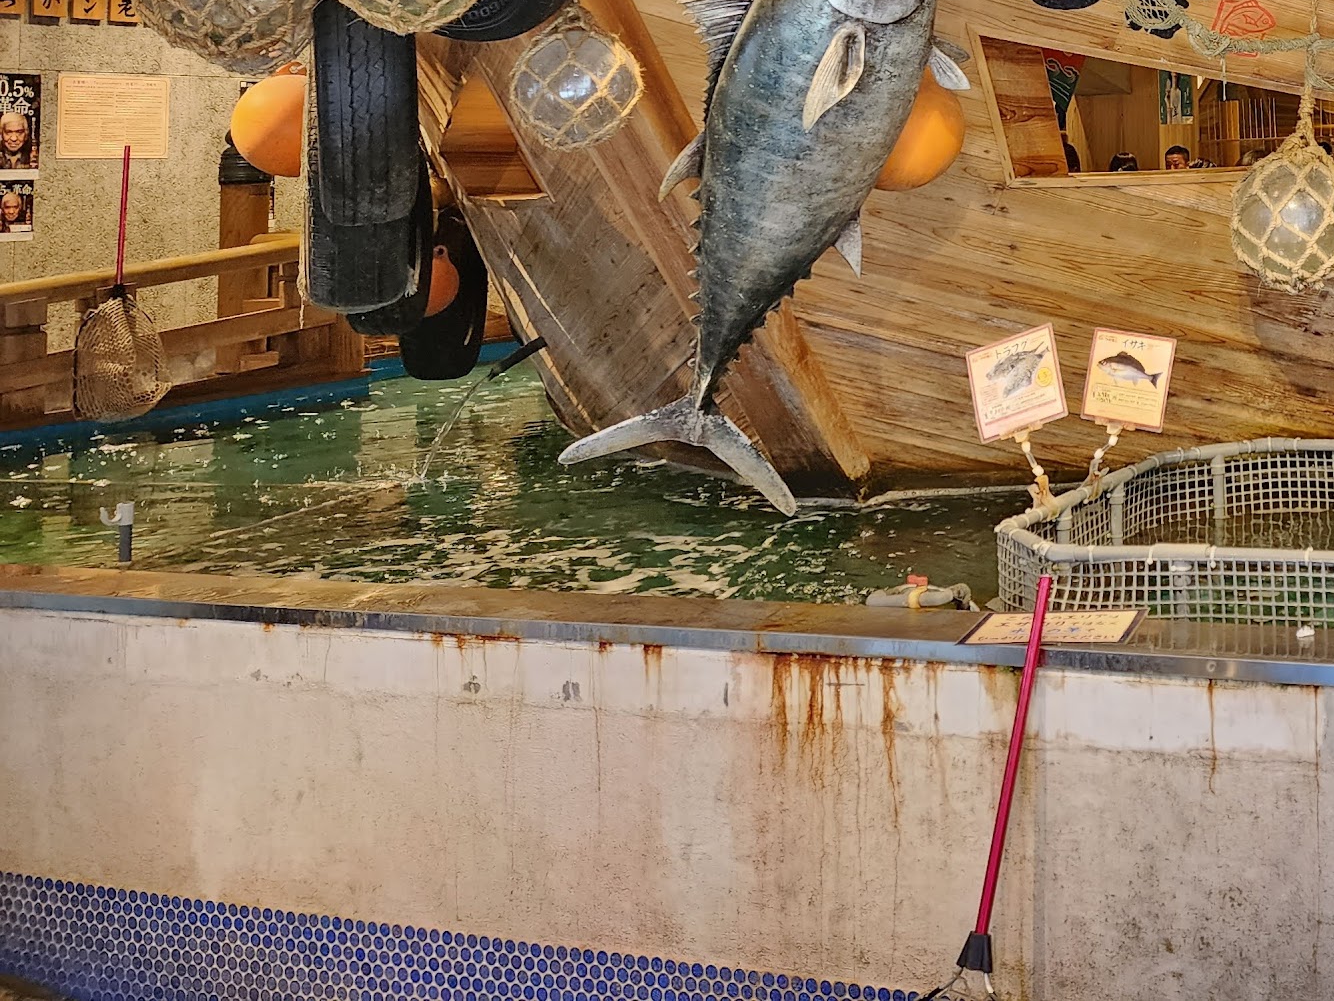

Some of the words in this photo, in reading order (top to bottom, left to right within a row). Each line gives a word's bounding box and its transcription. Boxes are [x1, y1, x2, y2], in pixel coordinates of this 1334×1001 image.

[994, 339, 1029, 360] トラフグ
[1122, 338, 1146, 351] イサキ
